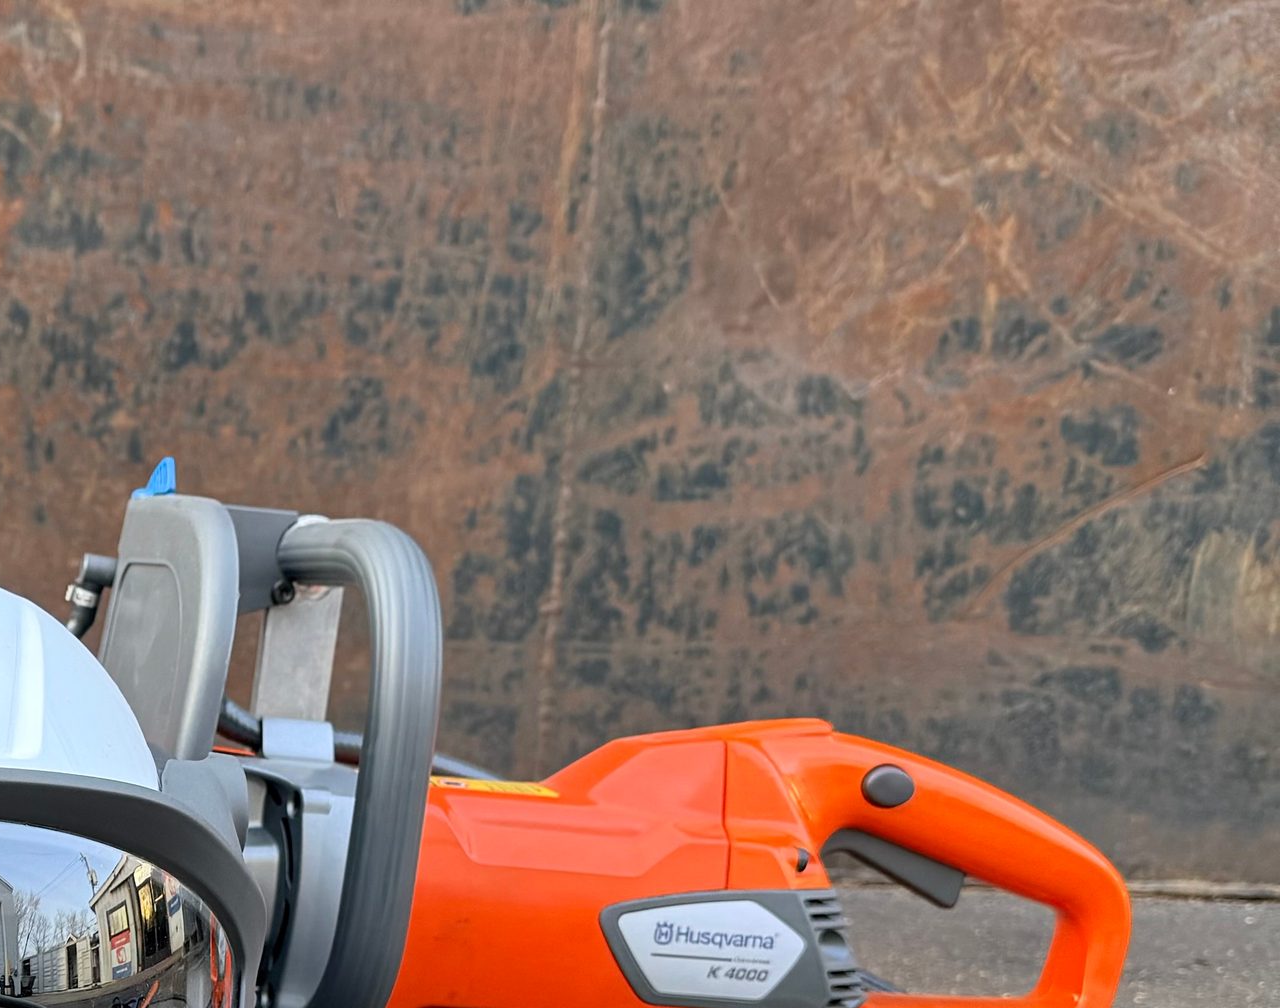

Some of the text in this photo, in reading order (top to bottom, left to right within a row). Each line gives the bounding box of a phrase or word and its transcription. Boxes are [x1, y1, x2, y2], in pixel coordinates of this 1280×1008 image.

[674, 925, 775, 950] Husqvarna
[706, 965, 769, 982] K 4000
